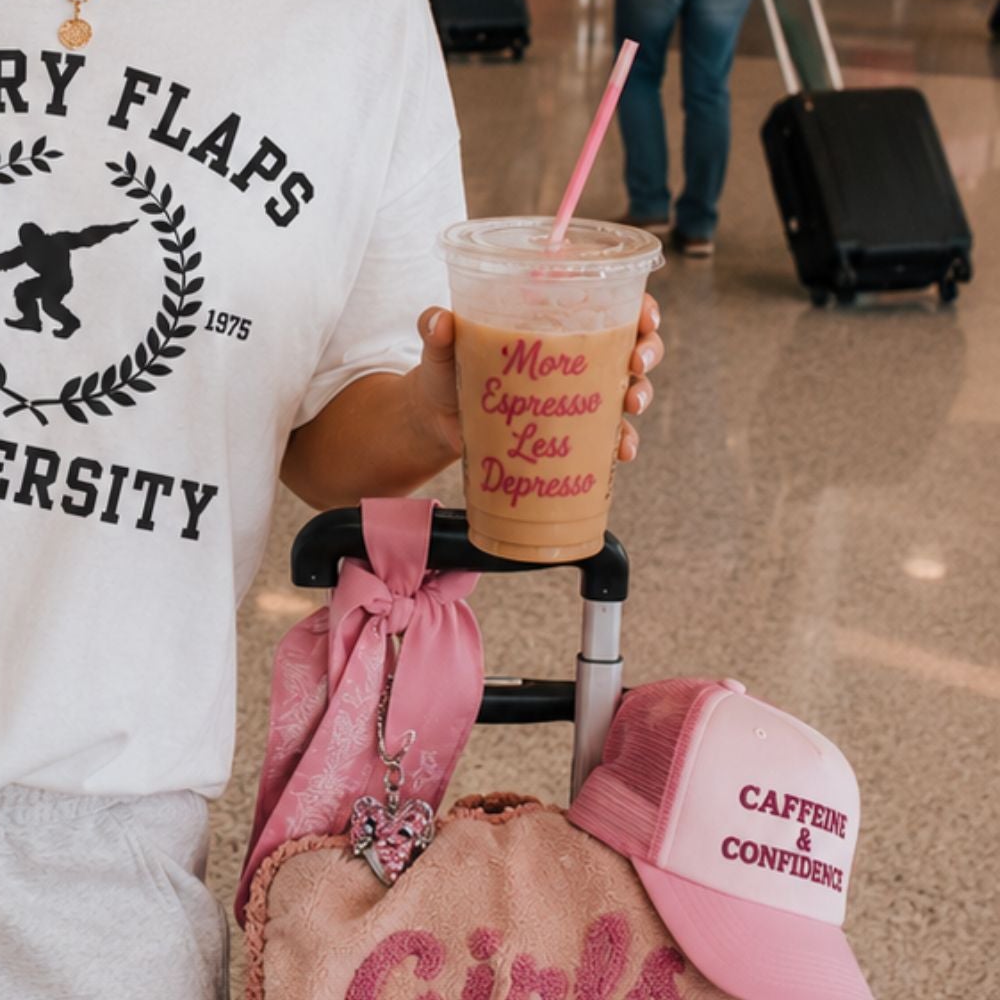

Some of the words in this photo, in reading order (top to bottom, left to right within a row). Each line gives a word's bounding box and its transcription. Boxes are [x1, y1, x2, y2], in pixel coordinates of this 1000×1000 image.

[107, 66, 315, 228] FLAPS
[204, 309, 253, 342] 1975
[481, 377, 602, 426] Espresso
[506, 422, 571, 465] Less
[481, 456, 597, 508] Depresso
[738, 784, 848, 840] CAFFEINE
[795, 826, 812, 854] &
